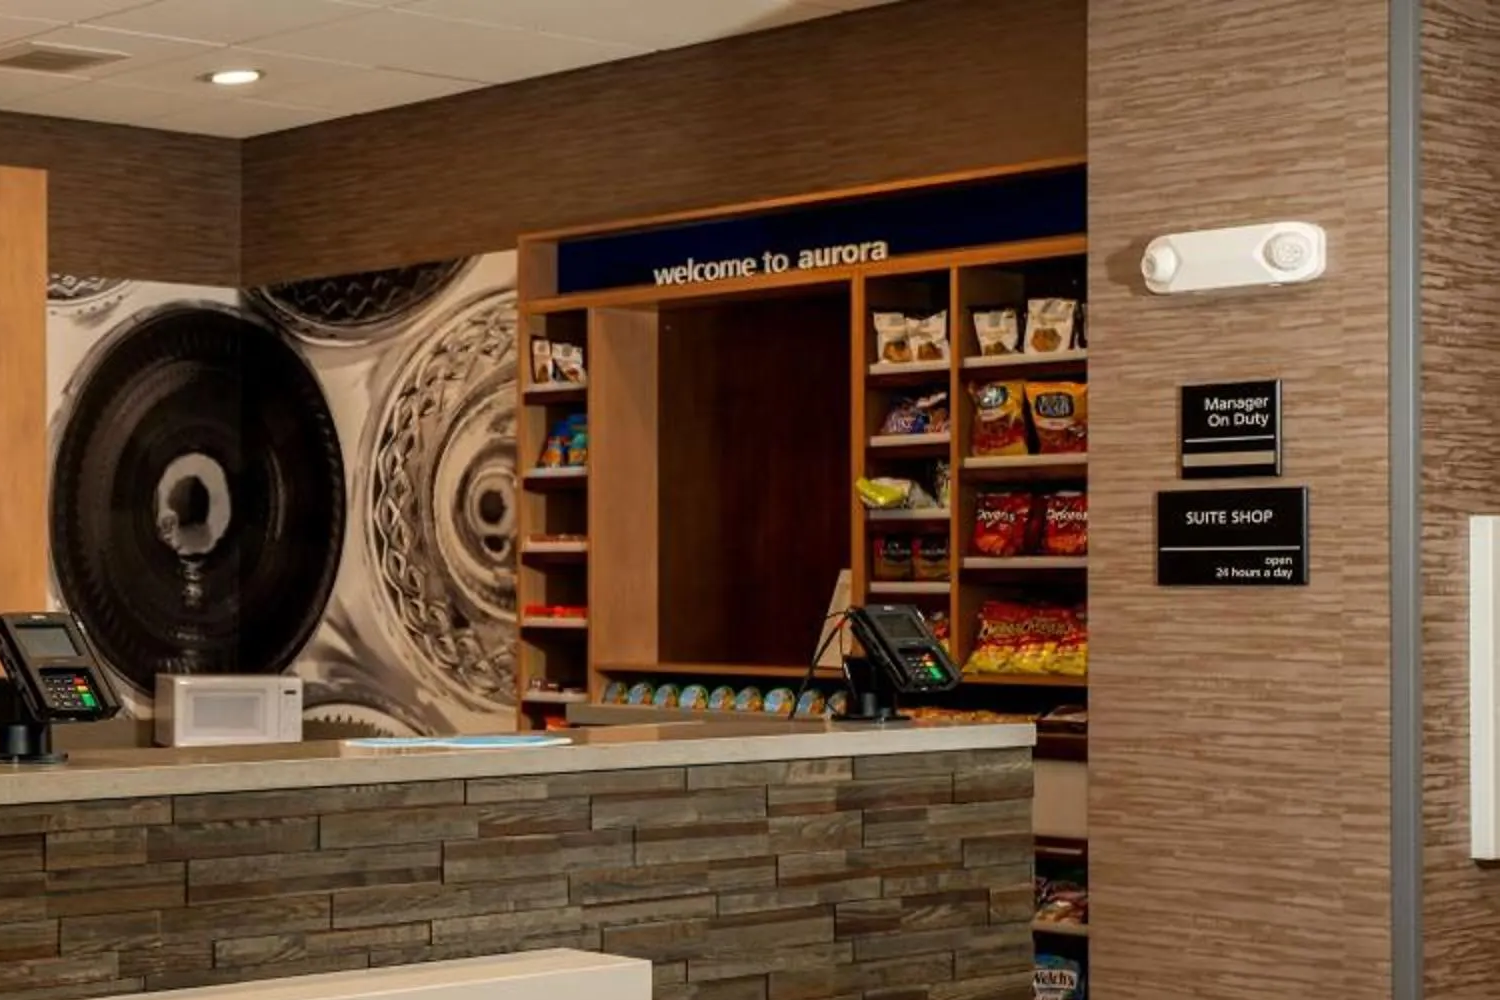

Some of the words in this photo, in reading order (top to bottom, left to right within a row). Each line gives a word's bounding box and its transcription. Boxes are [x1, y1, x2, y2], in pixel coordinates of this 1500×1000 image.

[653, 257, 757, 286] welcome
[762, 251, 789, 274] to
[798, 240, 889, 269] aurora
[1204, 396, 1269, 412] Manager
[1207, 413, 1230, 428] On
[1233, 411, 1270, 428] Duty
[1185, 510, 1227, 525] SUITE
[1231, 509, 1273, 524] SHOP
[1264, 556, 1293, 566] open
[1215, 567, 1229, 578] 24
[1231, 567, 1261, 577] hours
[1263, 569, 1271, 577] a
[1273, 566, 1293, 580] day
